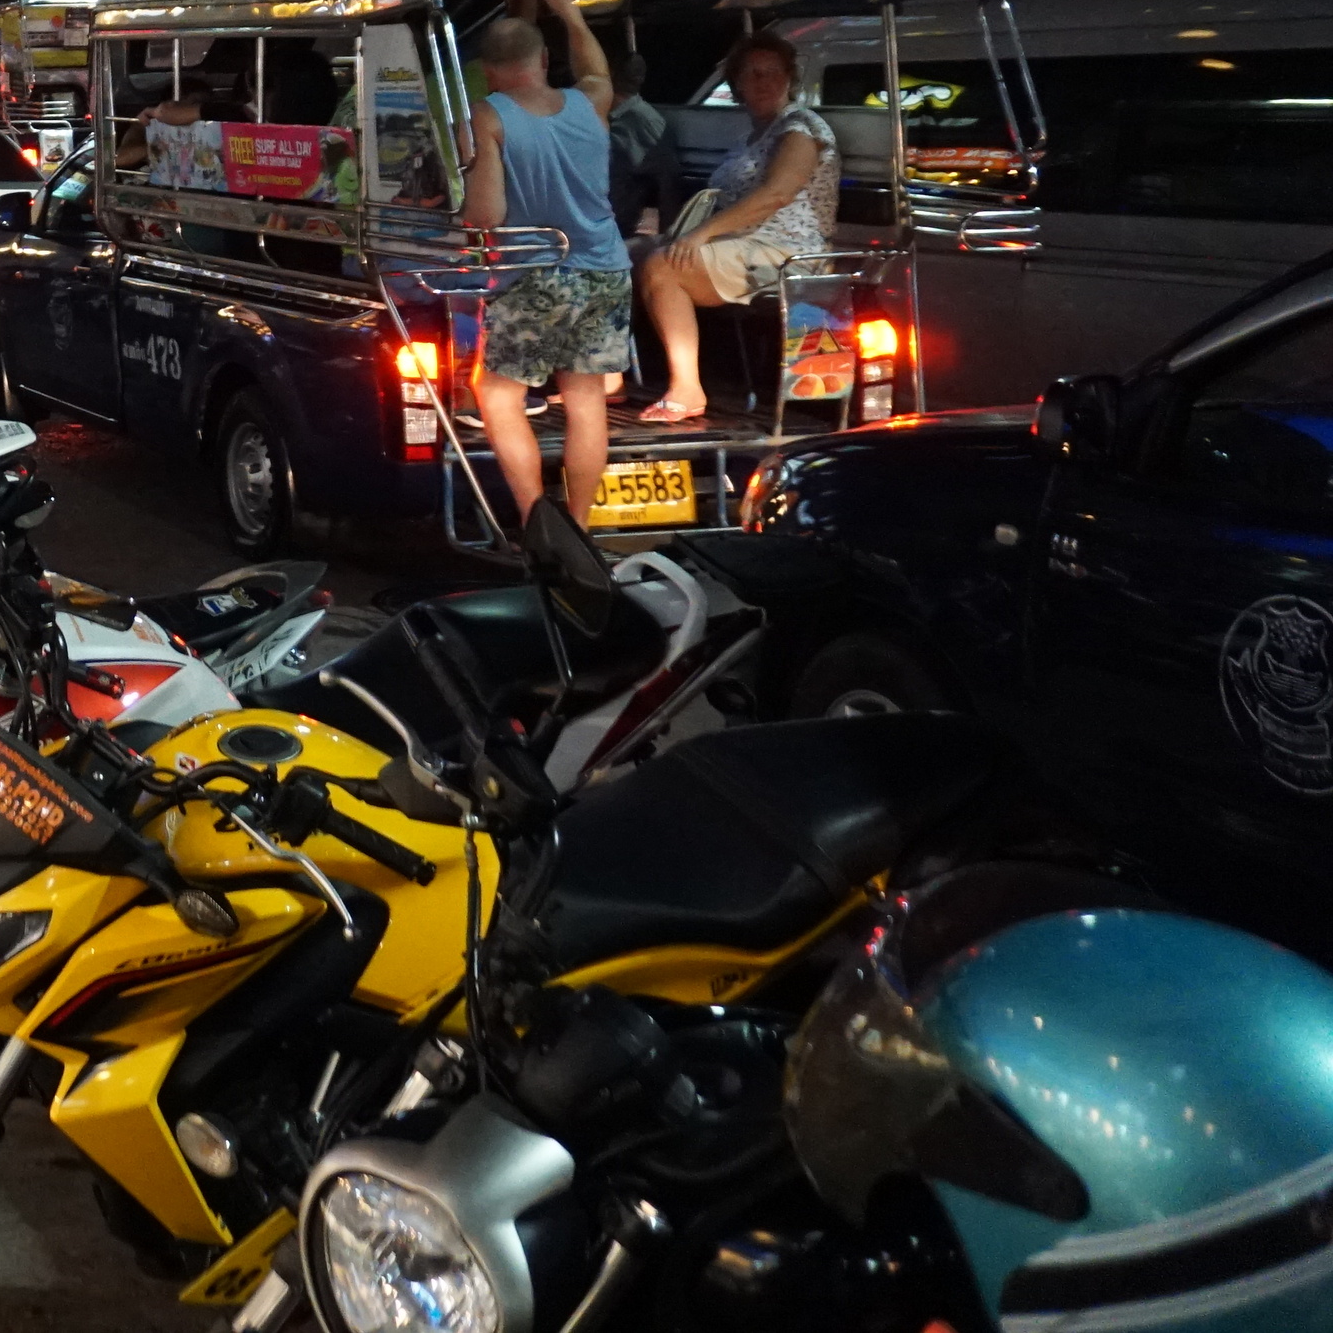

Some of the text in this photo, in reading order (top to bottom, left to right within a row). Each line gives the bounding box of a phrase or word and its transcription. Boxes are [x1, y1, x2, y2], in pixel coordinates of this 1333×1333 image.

[279, 140, 295, 157] ALL
[296, 140, 313, 158] DAY
[146, 333, 182, 380] 473
